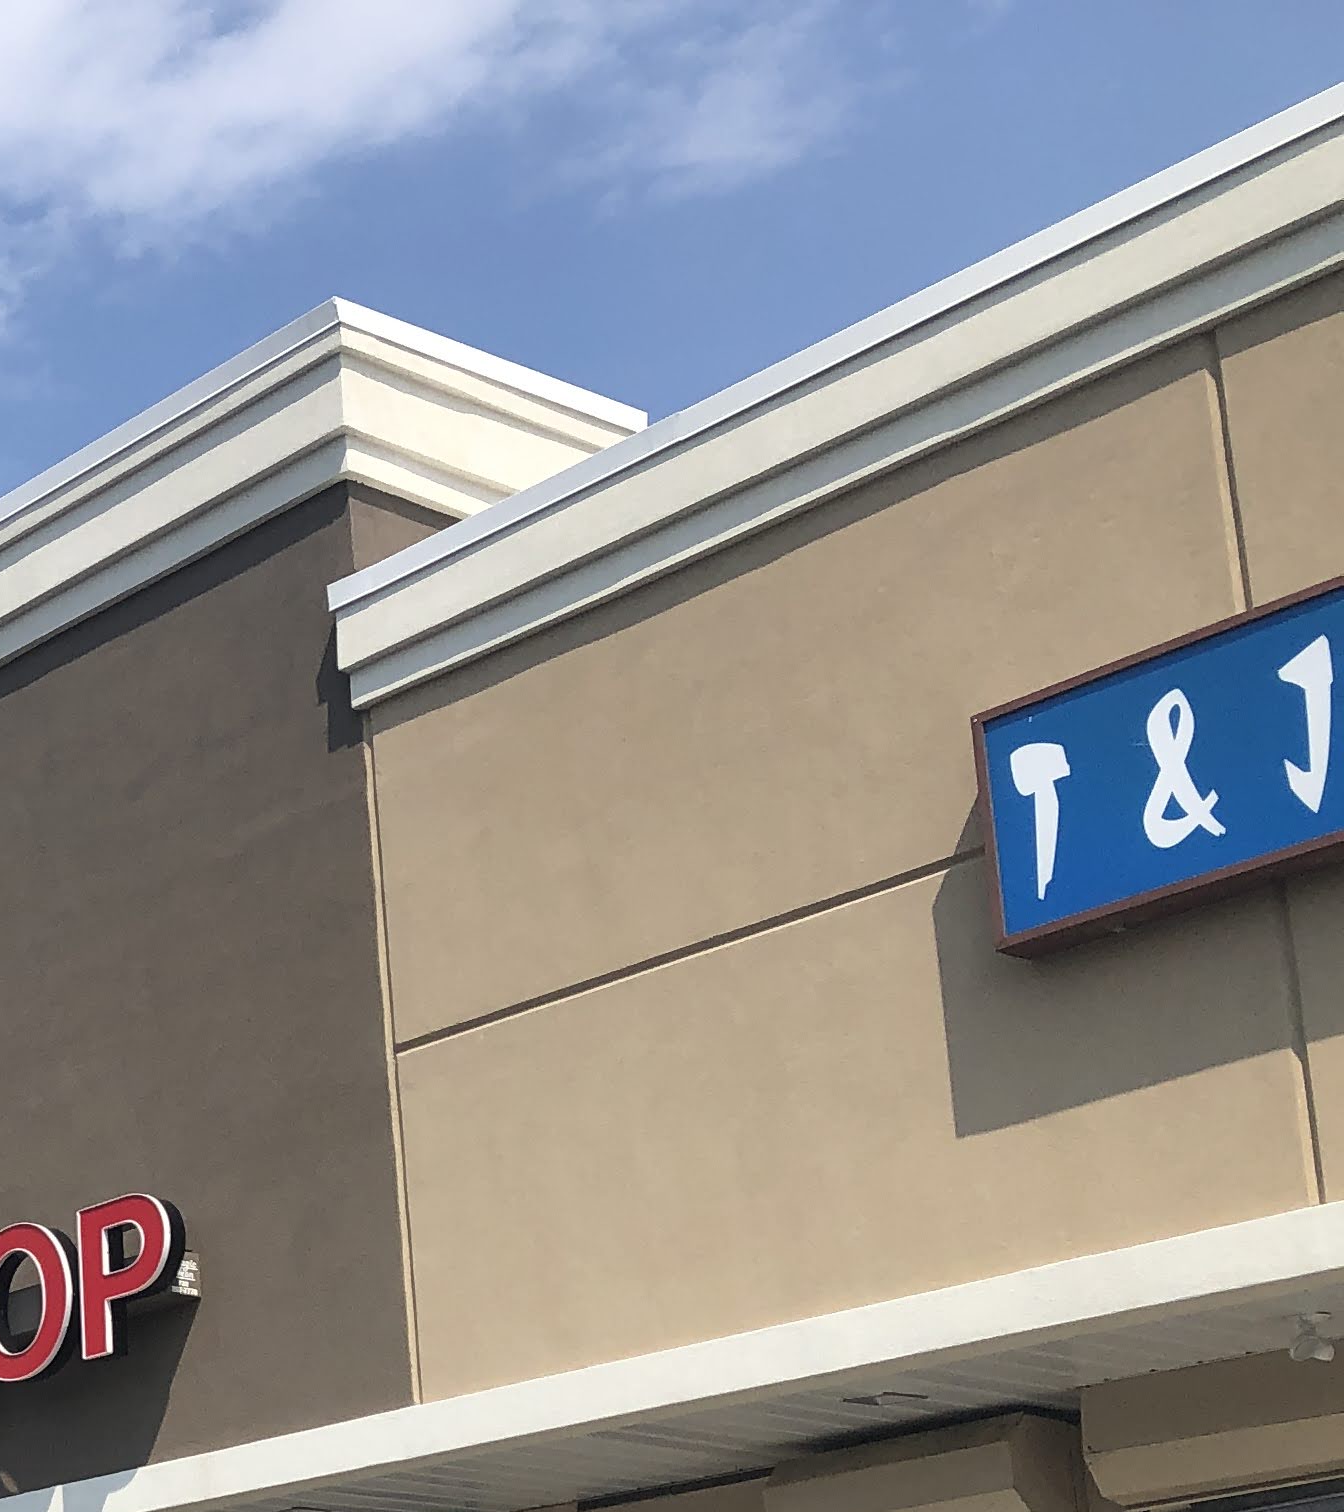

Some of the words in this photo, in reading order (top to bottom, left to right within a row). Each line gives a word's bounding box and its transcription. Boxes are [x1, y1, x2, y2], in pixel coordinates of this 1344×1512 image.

[1010, 743, 1070, 900] T
[1143, 688, 1226, 848] &
[1278, 634, 1333, 813] J
